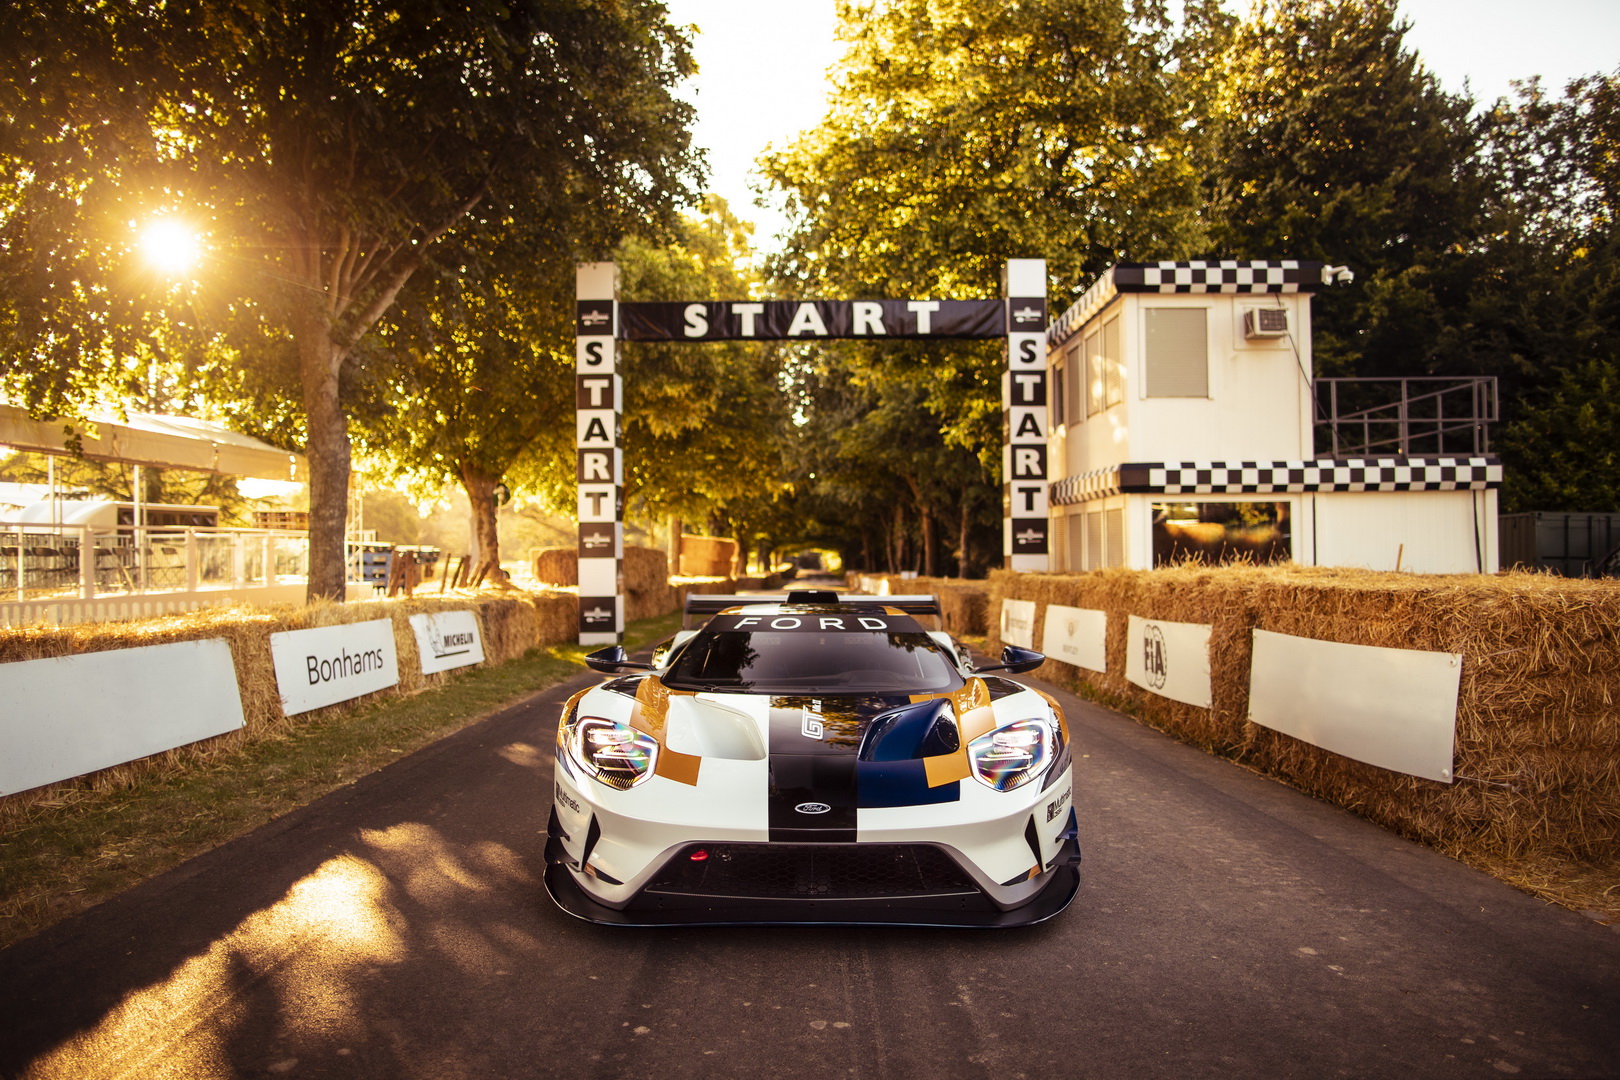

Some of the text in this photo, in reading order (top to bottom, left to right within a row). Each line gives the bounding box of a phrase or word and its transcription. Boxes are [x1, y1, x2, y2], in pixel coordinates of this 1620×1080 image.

[684, 301, 940, 338] START
[583, 341, 611, 517] START
[1015, 339, 1043, 512] START
[443, 632, 474, 648] MICHELIN
[733, 617, 888, 630] FORD
[306, 647, 384, 685] Bonhams
